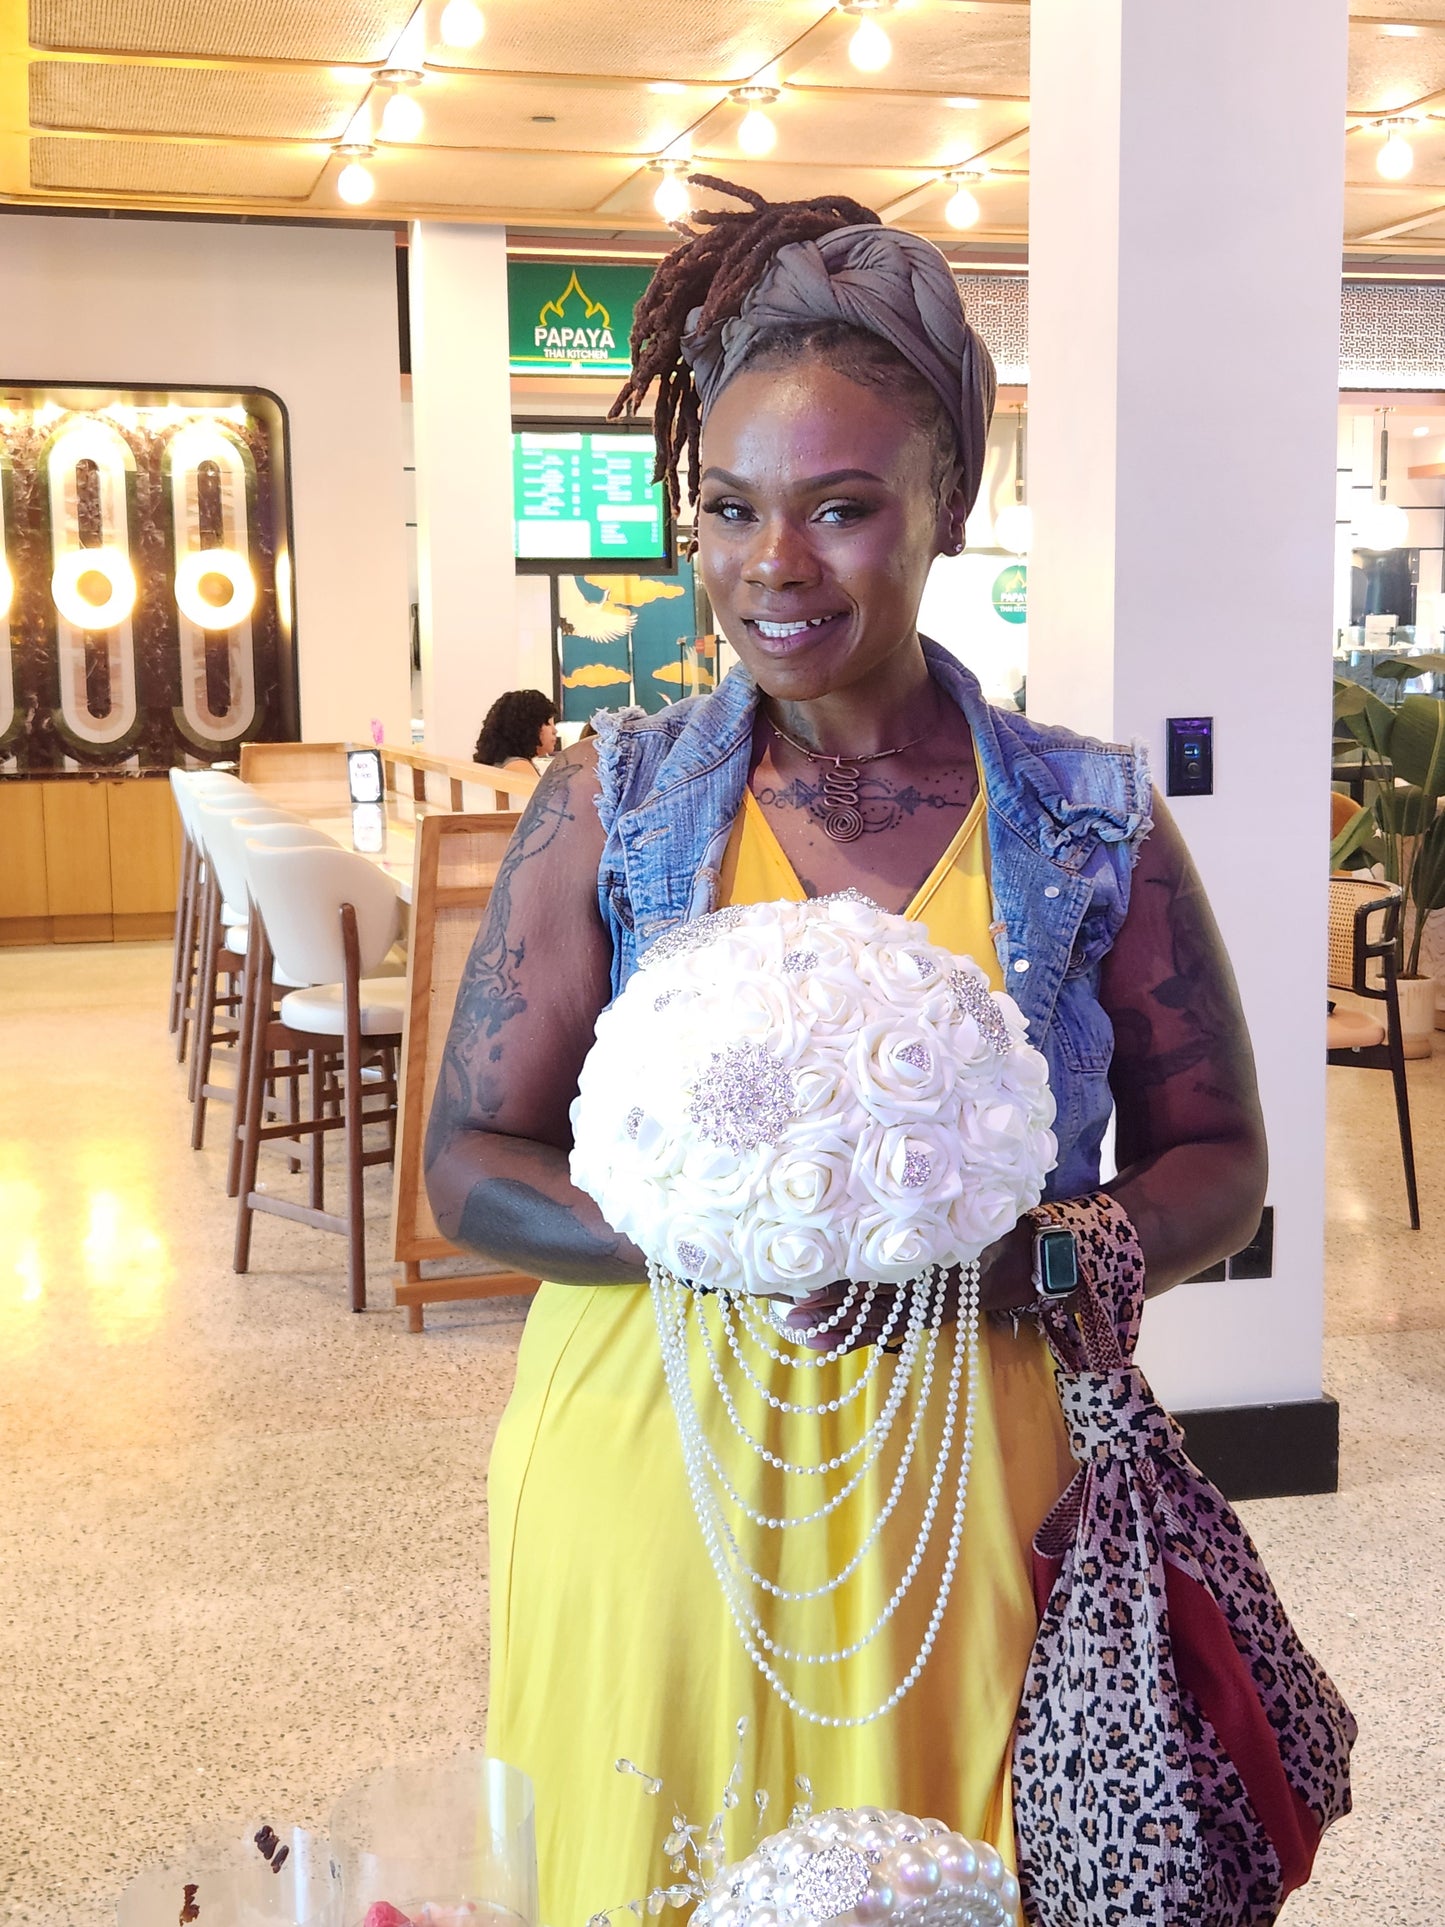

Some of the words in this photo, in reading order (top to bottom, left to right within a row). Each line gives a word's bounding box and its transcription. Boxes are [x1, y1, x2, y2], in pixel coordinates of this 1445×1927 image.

[534, 327, 615, 348] PAPAYA
[543, 348, 565, 358] THAI
[566, 349, 609, 360] KITCHEN
